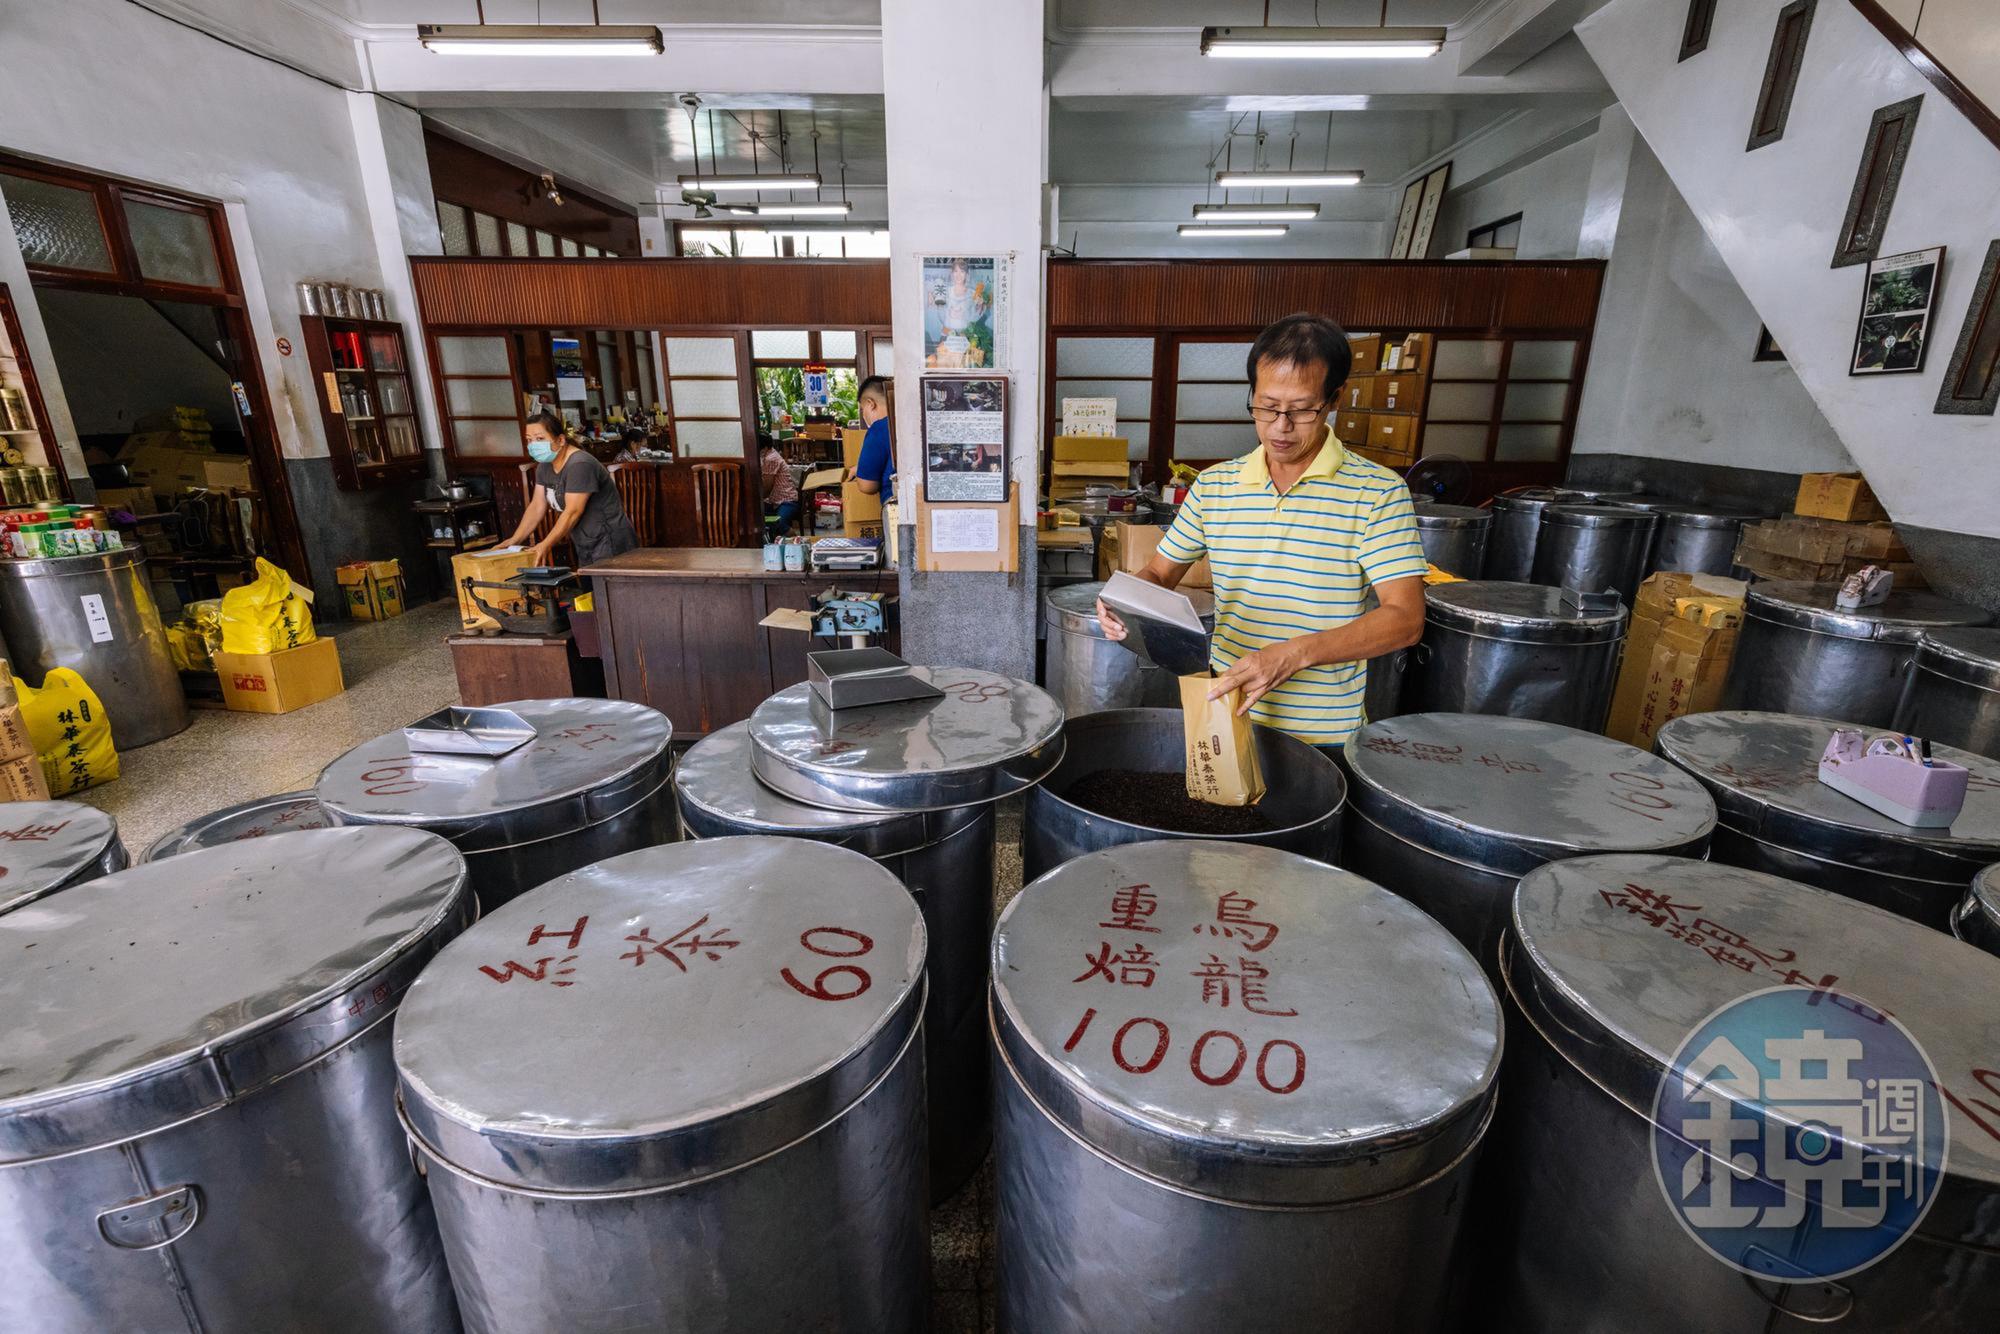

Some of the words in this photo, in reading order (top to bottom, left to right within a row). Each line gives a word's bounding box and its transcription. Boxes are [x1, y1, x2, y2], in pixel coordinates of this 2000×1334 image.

[810, 375, 822, 391] 30
[58, 708, 95, 785] 林華泰茶行
[1197, 740, 1220, 796] 林華泰茶行
[1608, 771, 1673, 822] 160
[478, 914, 741, 988] 紅茶
[780, 926, 874, 1001] 60
[1072, 883, 1162, 988] 重焙
[1063, 1007, 1306, 1095] 1000
